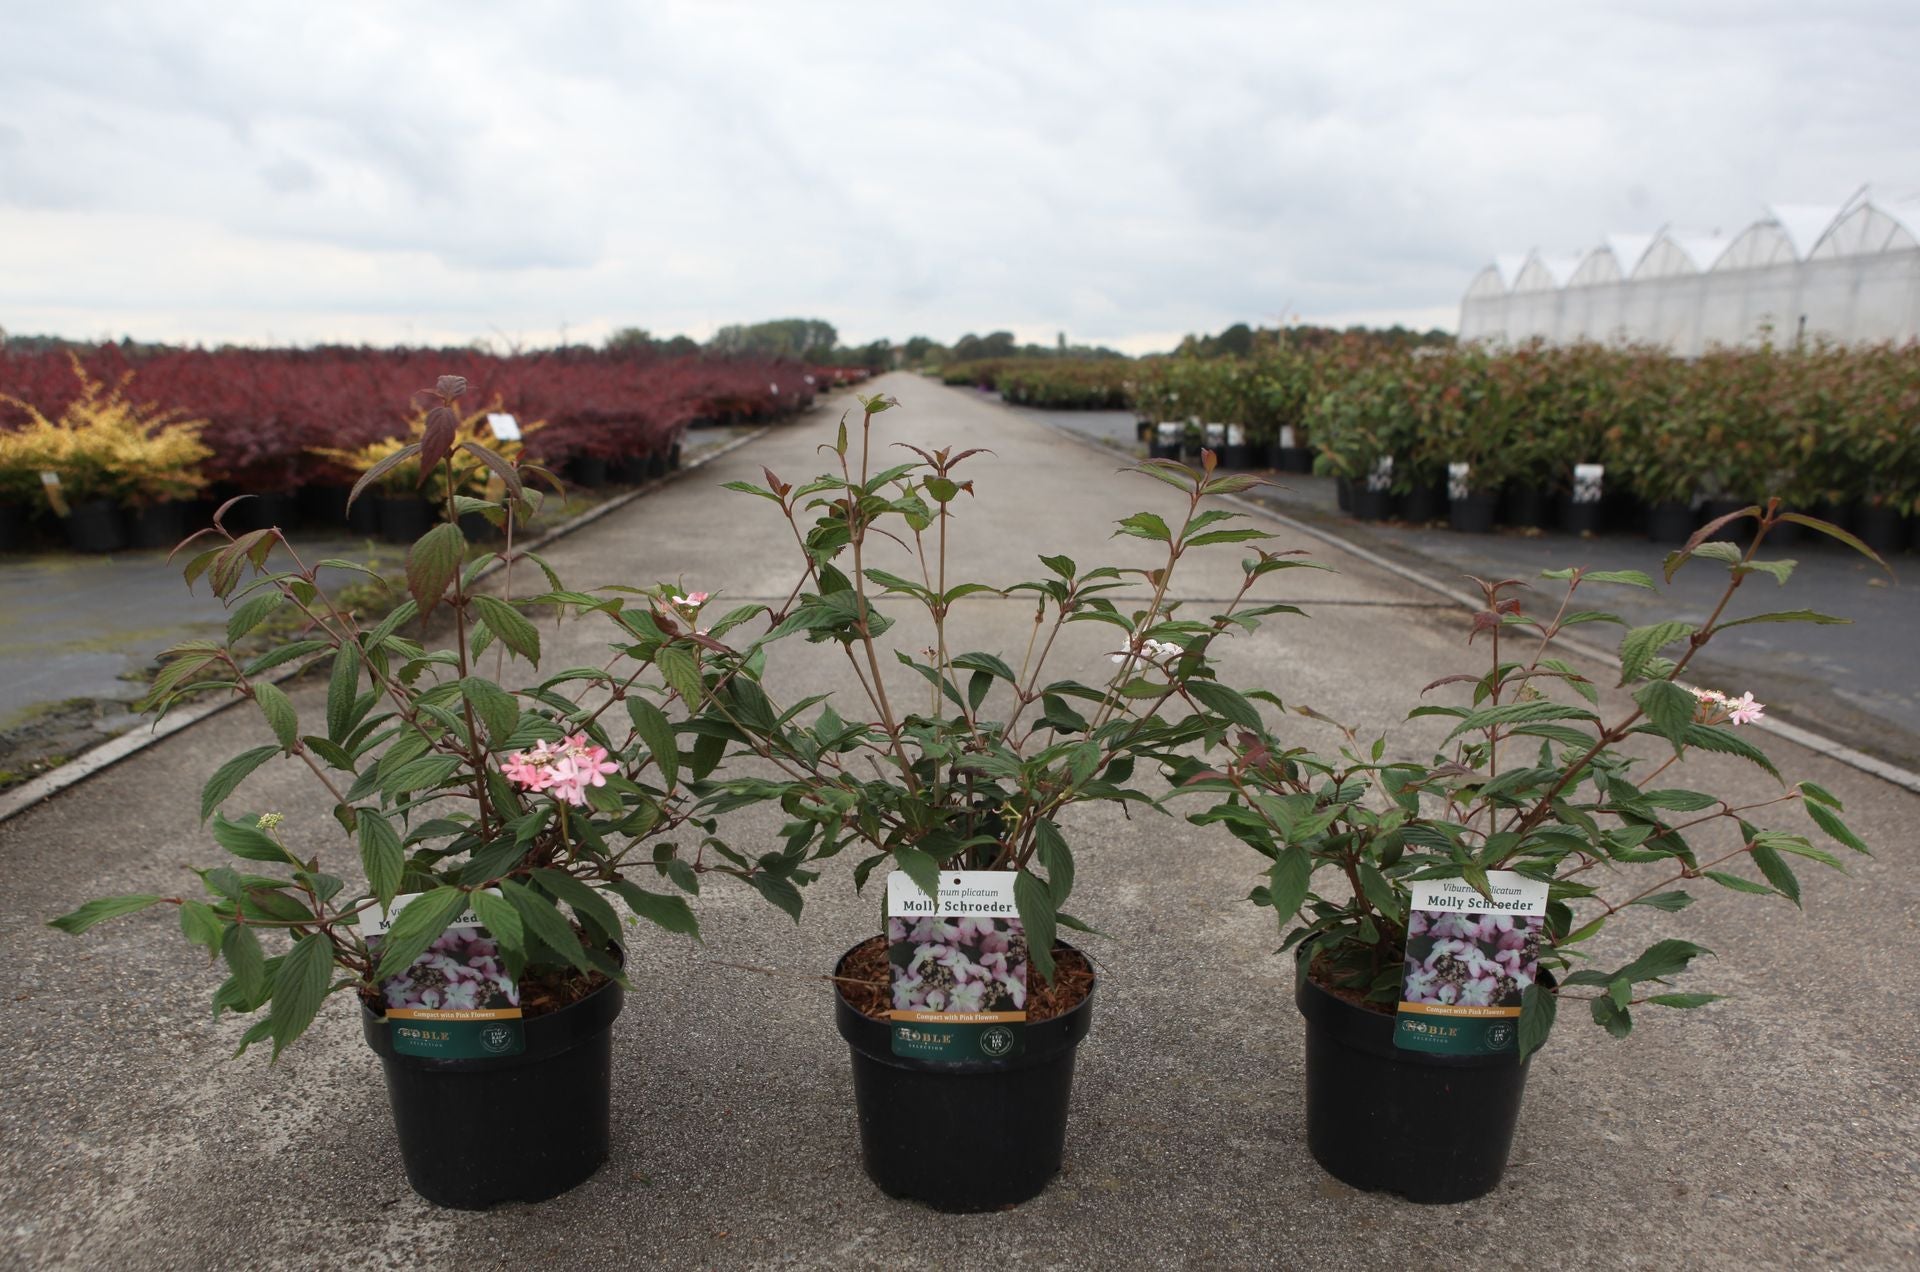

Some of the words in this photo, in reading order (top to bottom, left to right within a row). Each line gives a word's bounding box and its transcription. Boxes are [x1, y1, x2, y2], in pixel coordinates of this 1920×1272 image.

[961, 888, 999, 898] plicatum
[1489, 886, 1522, 895] licatum
[944, 900, 1013, 913] Schroeder
[1428, 895, 1464, 909] Molly
[1467, 898, 1534, 911] Schroeder
[1426, 1006, 1453, 1014] Compact
[916, 1013, 943, 1021] Compact
[1403, 1020, 1457, 1037] NOBLE
